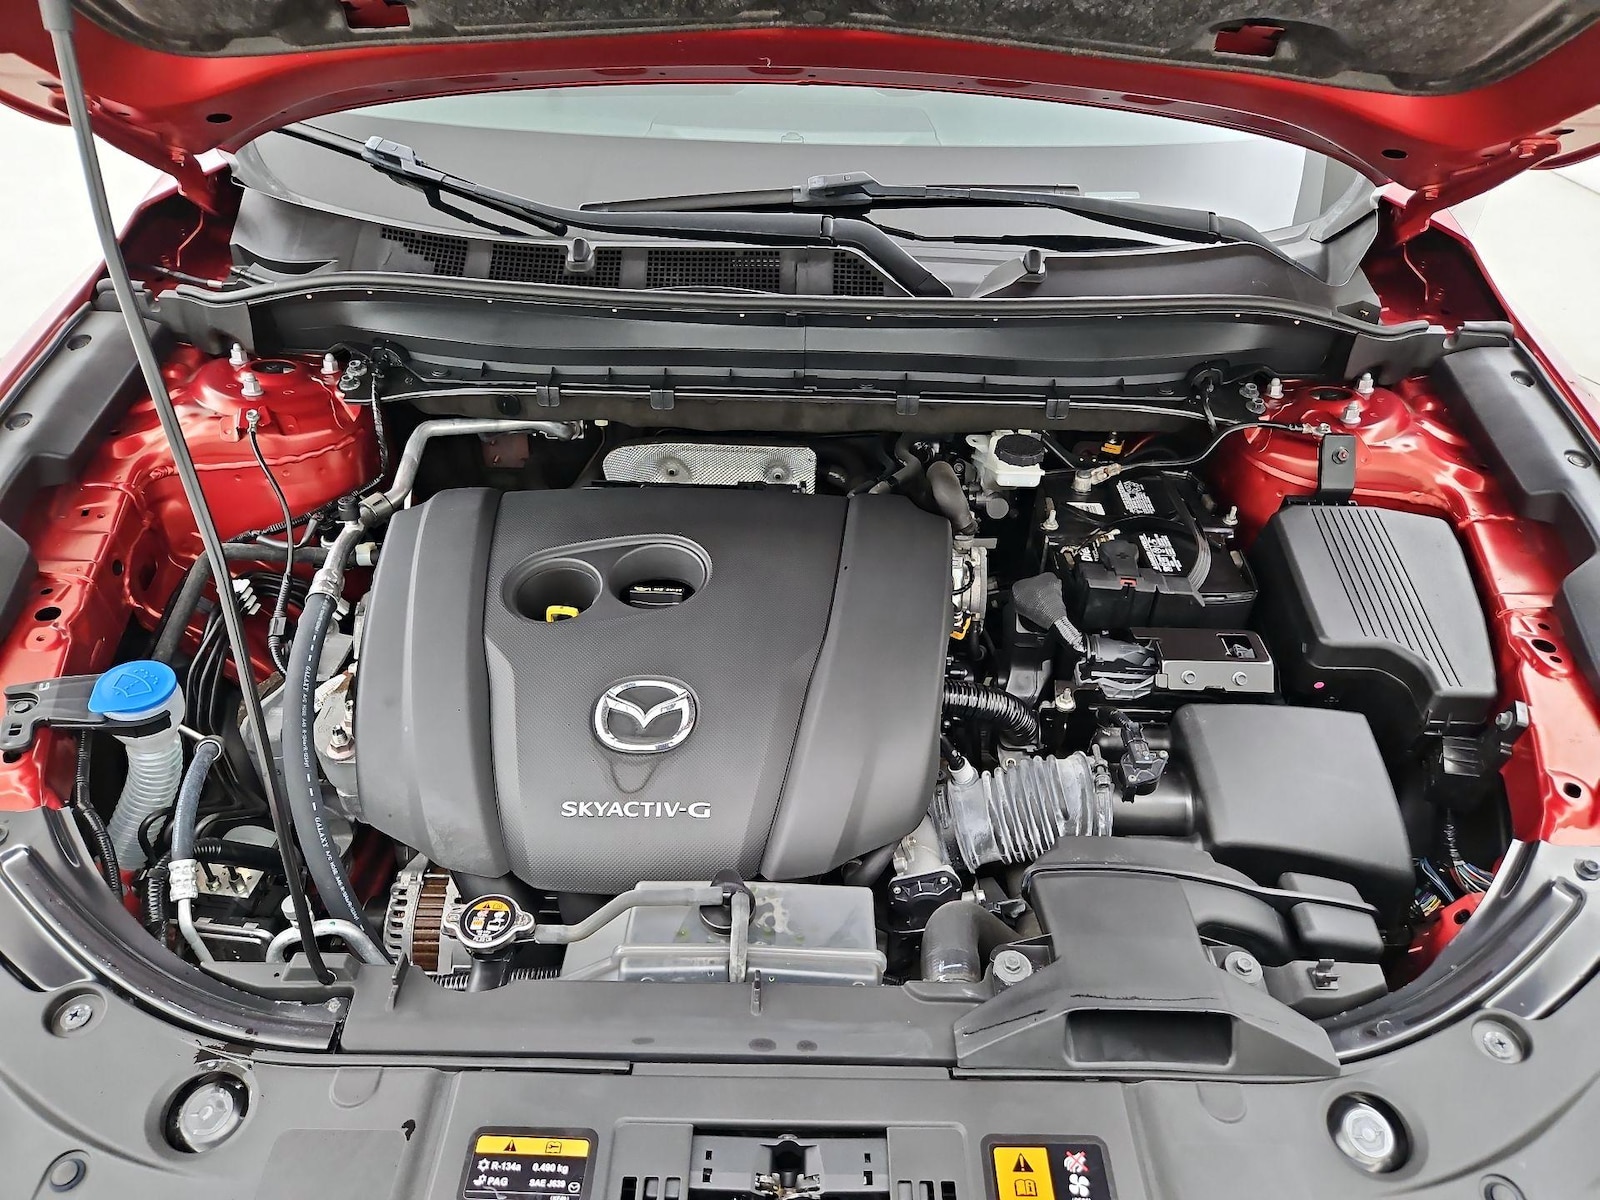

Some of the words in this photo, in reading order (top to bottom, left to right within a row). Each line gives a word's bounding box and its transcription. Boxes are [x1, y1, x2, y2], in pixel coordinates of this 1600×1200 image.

[303, 666, 311, 692] GALAXY
[561, 801, 712, 819] SKYACTIV-G
[315, 817, 329, 848] GALAXY
[491, 1161, 522, 1172] R-134a
[557, 1163, 570, 1175] kg
[487, 1176, 509, 1187] PAG
[529, 1178, 546, 1188] SAE
[547, 1179, 566, 1188] J639
